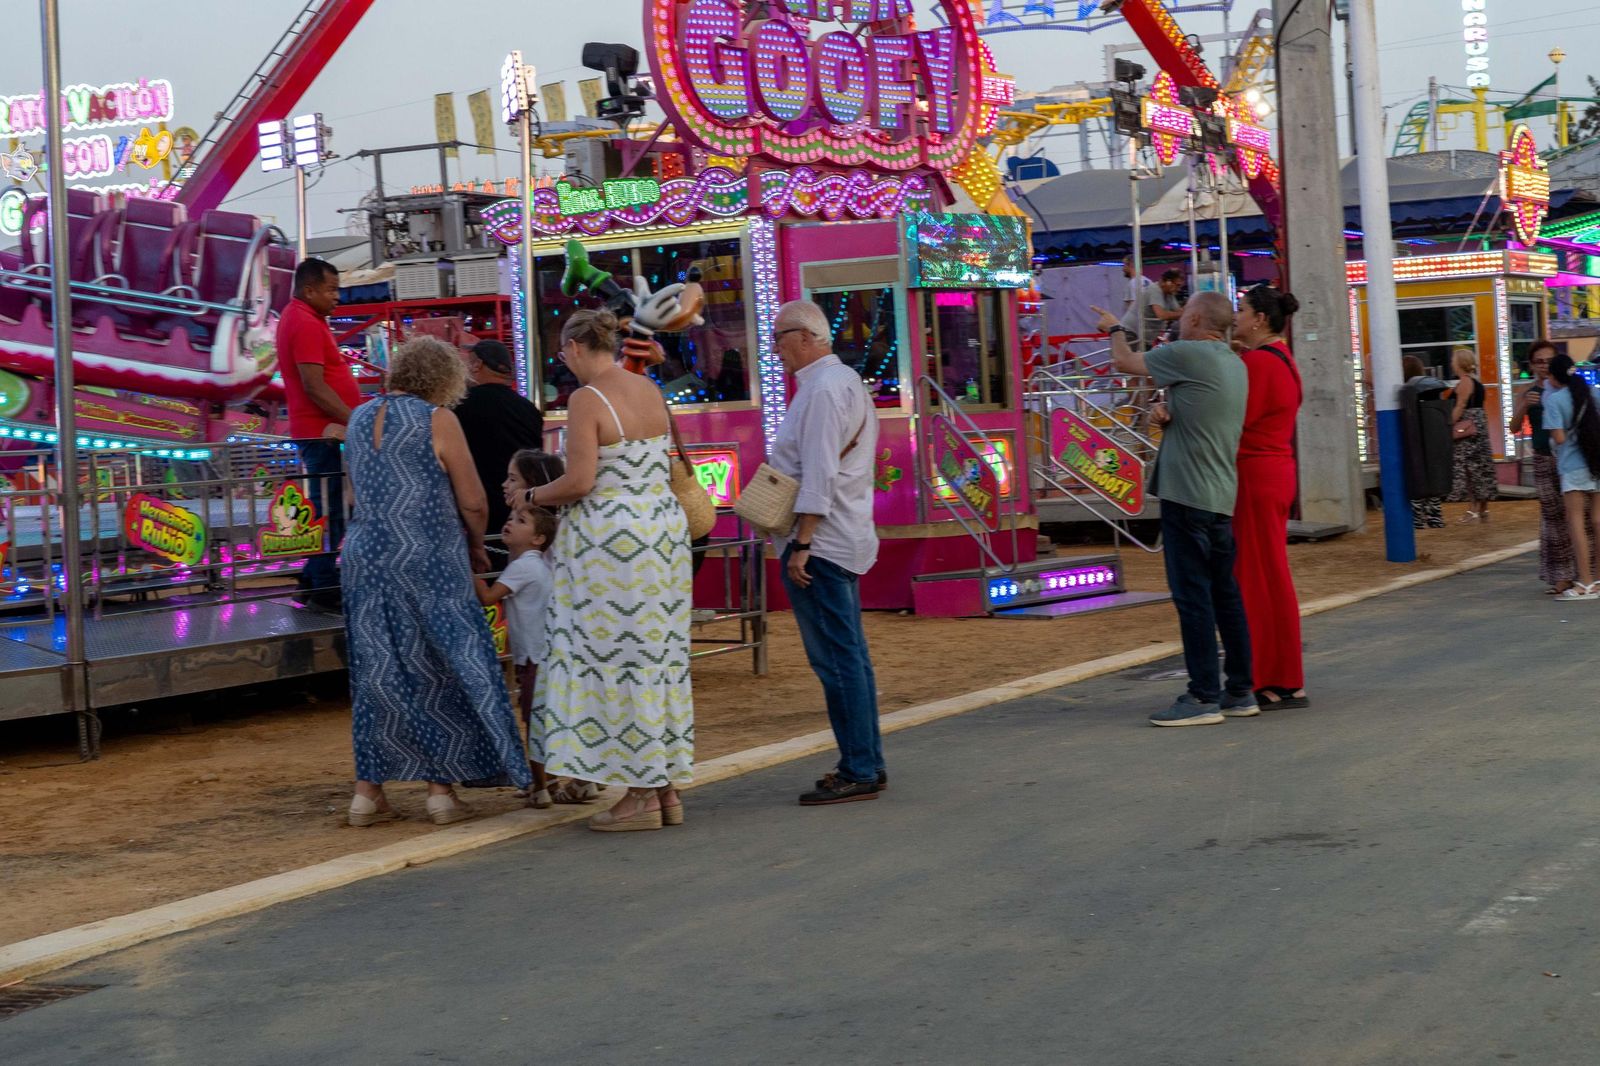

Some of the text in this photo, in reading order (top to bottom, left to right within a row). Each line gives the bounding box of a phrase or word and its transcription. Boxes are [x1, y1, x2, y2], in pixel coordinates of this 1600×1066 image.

[684, 0, 957, 133] GOOFY
[67, 77, 170, 125] VACILÓN
[140, 500, 195, 537] Hermanos
[141, 518, 187, 557] Rubio
